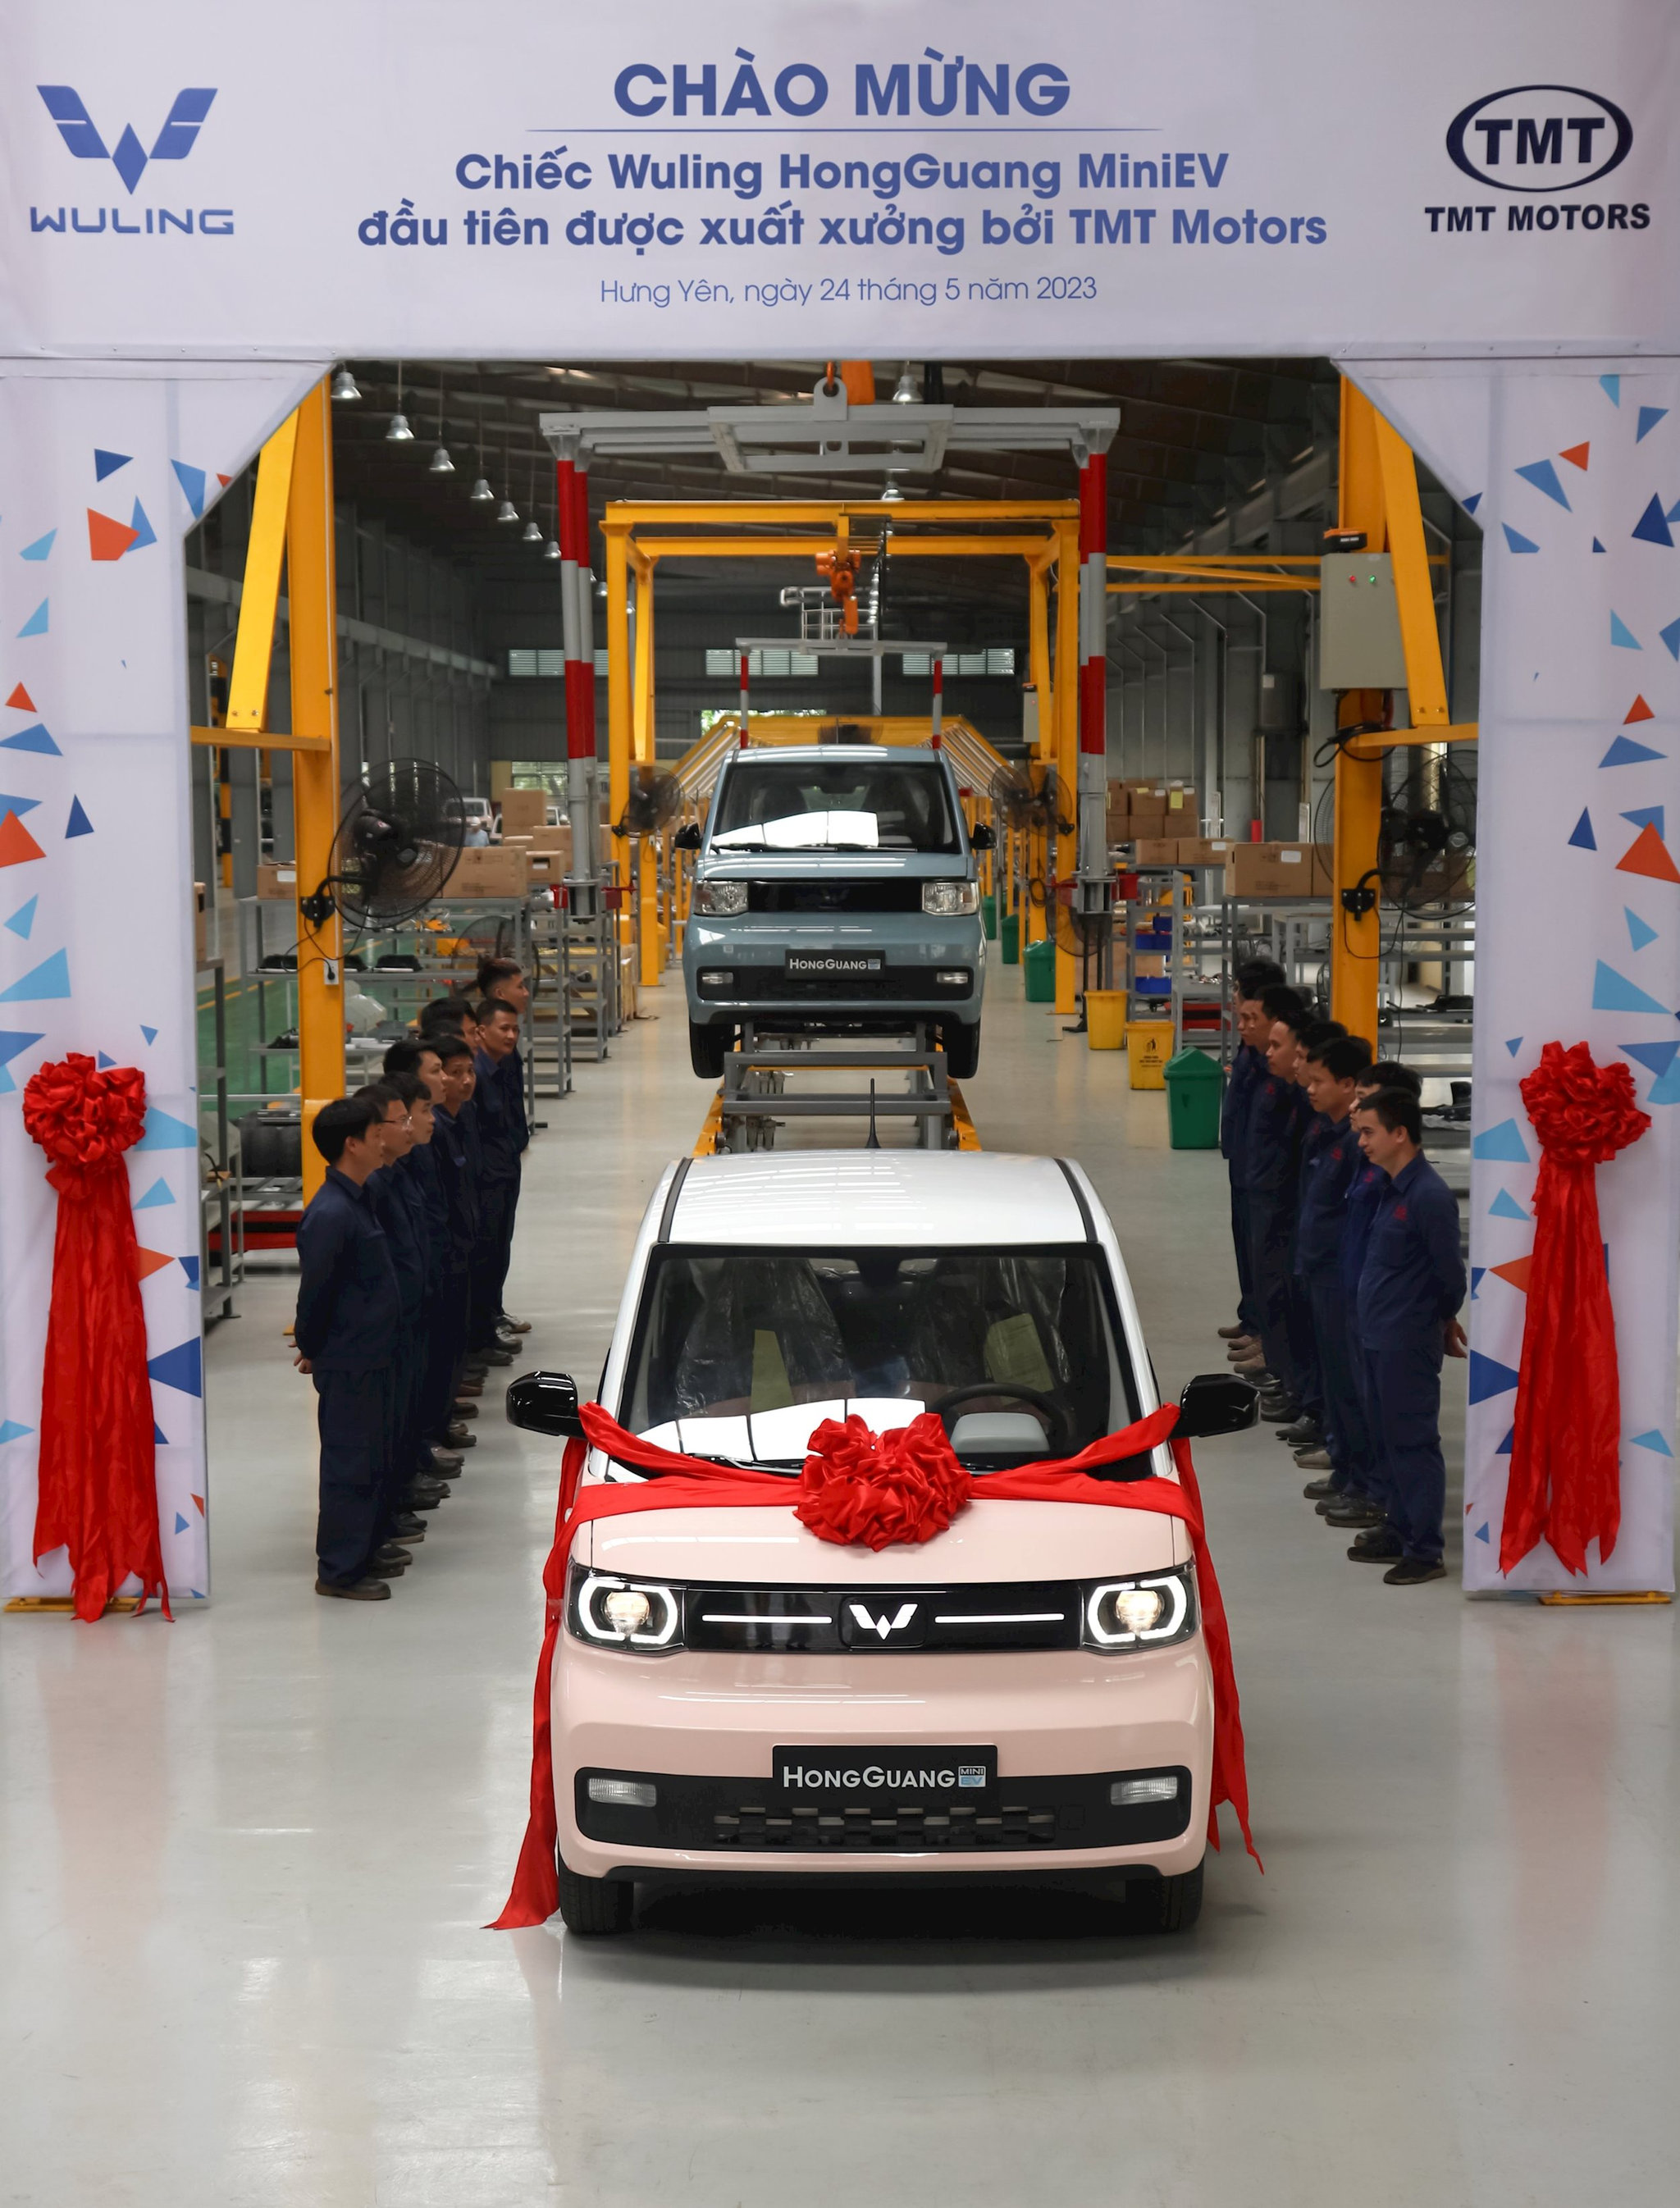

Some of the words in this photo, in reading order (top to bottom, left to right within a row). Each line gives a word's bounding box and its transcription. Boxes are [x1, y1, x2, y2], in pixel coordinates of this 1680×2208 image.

[614, 47, 829, 117] CHÀO
[855, 46, 1071, 116] MỪNG
[1474, 117, 1605, 165] TMT
[455, 144, 592, 189] Chiếc
[608, 153, 762, 199] Wuling
[779, 153, 1061, 199] HongGuang
[1078, 153, 1230, 189] MiniEV
[30, 206, 235, 235] WULING
[358, 197, 448, 246] đầu
[463, 207, 549, 245] tiên
[565, 209, 684, 255] được
[699, 199, 805, 244] xuất
[818, 203, 965, 255] xưởng
[982, 203, 1054, 244] bởi
[1069, 209, 1156, 244] TMT
[1171, 209, 1327, 244] Motors
[1424, 205, 1496, 232] TMT
[1508, 203, 1650, 231] MOTORS
[600, 280, 671, 308] Hưng
[678, 279, 735, 306] Yên,
[743, 279, 813, 307] ngày
[820, 278, 851, 301] 24
[856, 276, 937, 307] tháng
[944, 278, 961, 301] 5
[968, 277, 1029, 300] năm
[1036, 276, 1098, 299] 2023
[960, 1768, 984, 1776] MINI
[960, 1776, 983, 1786] EV
